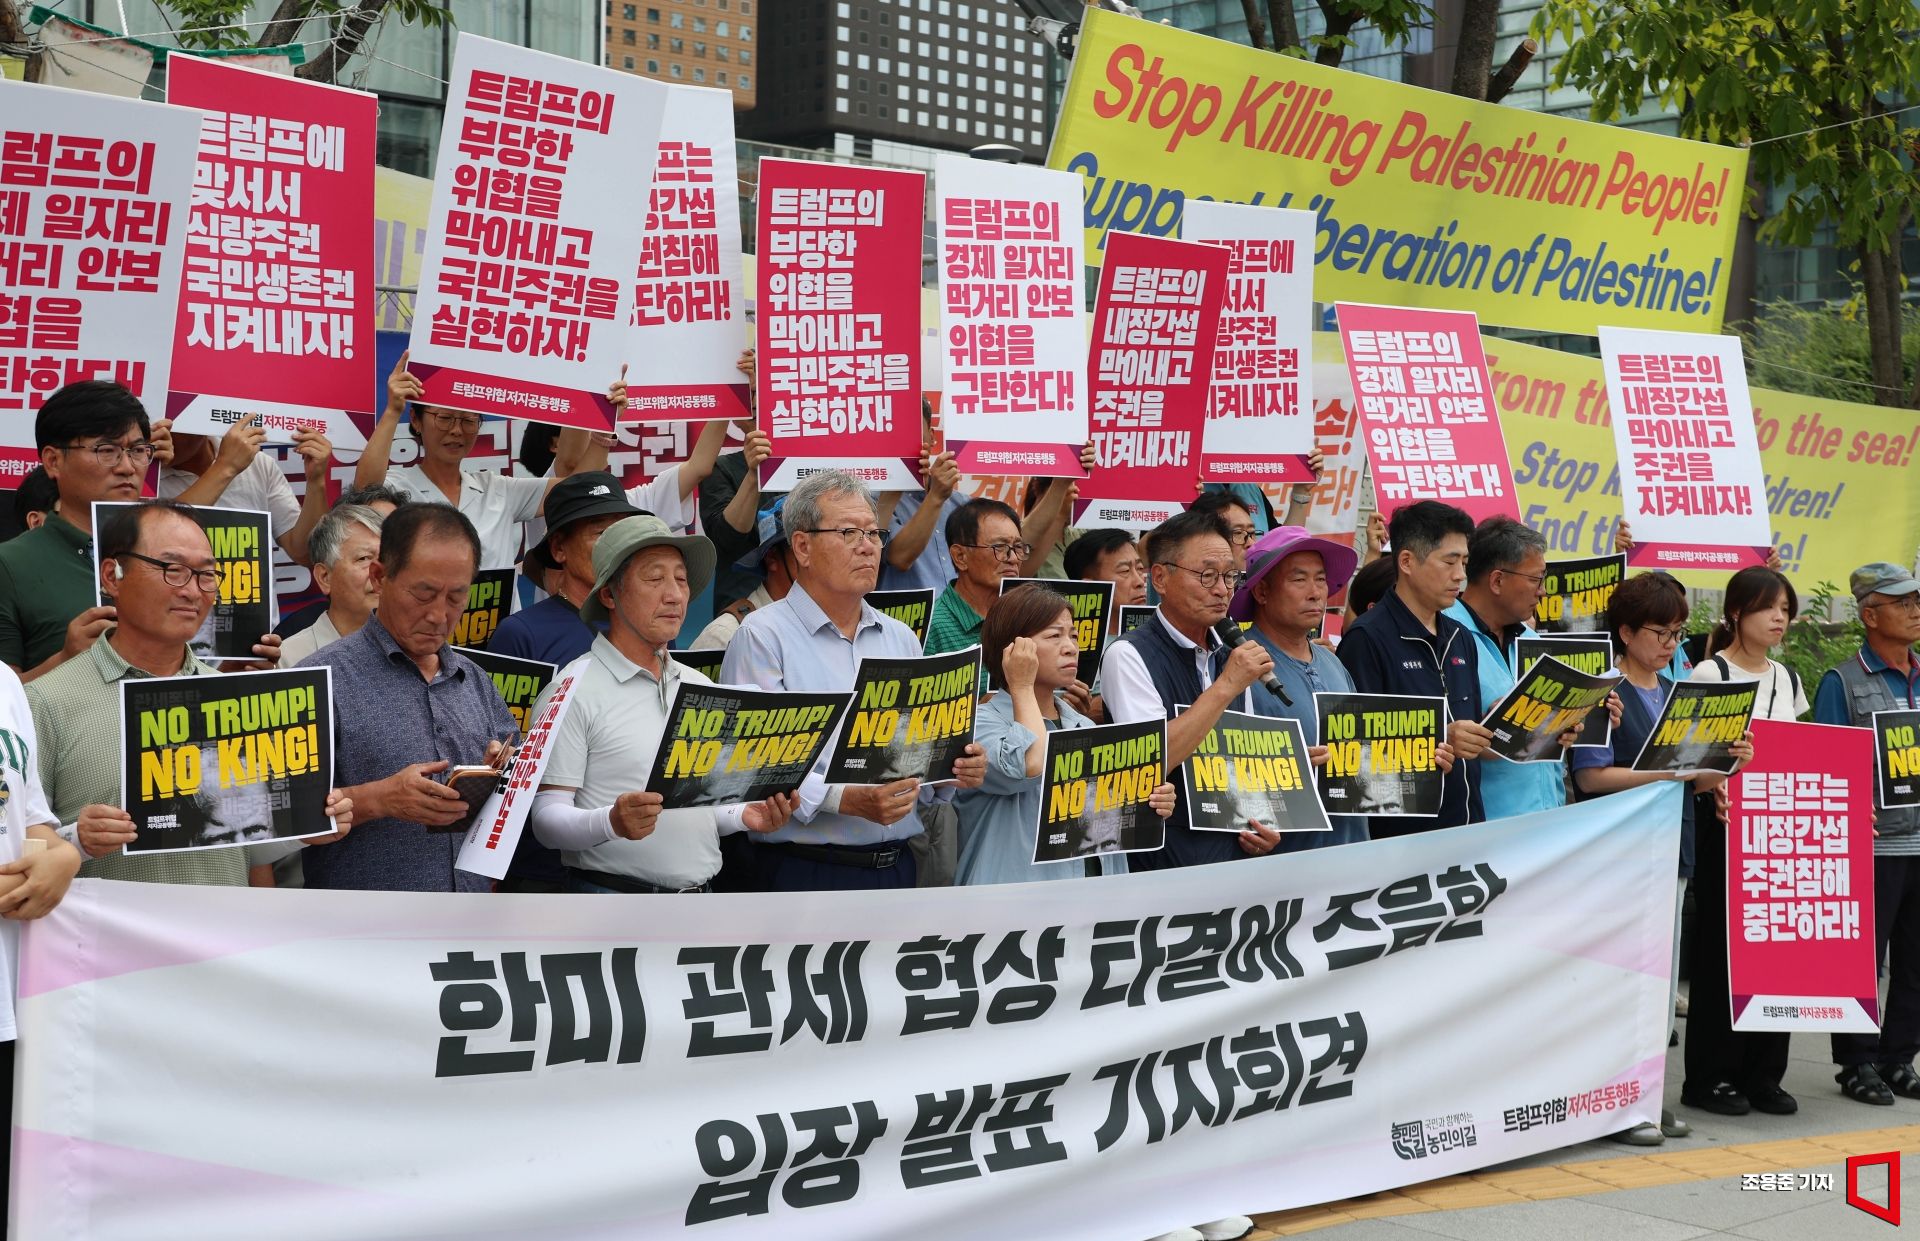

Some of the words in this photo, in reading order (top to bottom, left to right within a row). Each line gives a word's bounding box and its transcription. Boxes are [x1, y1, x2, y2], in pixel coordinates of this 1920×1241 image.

[465, 69, 615, 135] 트럼프의
[200, 112, 344, 172] 트럼프에
[458, 116, 573, 174] 부당한
[1093, 43, 1222, 153] Stop
[1220, 75, 1383, 187] Killing
[1376, 110, 1601, 208] Palestinian
[1602, 150, 1730, 235] People!
[1, 131, 155, 194] 럼프의
[653, 142, 713, 183] 프는
[191, 162, 301, 217] 맞서서
[451, 166, 563, 220] 위협을
[645, 187, 716, 230] 간섭
[770, 187, 885, 227] 트럼프의
[0, 190, 30, 237] 제
[43, 194, 171, 246] 일자리
[188, 211, 320, 263] 식량주권
[945, 197, 1060, 242] 트럼프의
[1066, 152, 1264, 250] Supp
[1278, 192, 1490, 291] iberation
[1491, 221, 1545, 296] of
[1532, 236, 1722, 314] Palestine!
[445, 210, 593, 270] 막아내고
[637, 233, 720, 278] 권침해
[769, 229, 857, 269] 부당한
[1198, 240, 1294, 274] 럼프에
[0, 241, 63, 289] 거리
[76, 246, 161, 293] 안보
[945, 244, 995, 280] 경제
[1004, 245, 1074, 280] 일자리
[187, 256, 354, 310] 국민생존권
[437, 257, 619, 320] 국민주권을
[769, 271, 853, 311] 위협을
[947, 284, 1019, 318] 먹거리
[1027, 284, 1074, 318] 안보
[1110, 266, 1207, 306] 트럼프의
[1222, 279, 1265, 313] 서서
[0, 293, 82, 350] 협을
[629, 280, 731, 327] 단하라!
[187, 302, 354, 359] 지켜내자!
[430, 304, 590, 362] 실현하자!
[769, 313, 882, 353] 막아내고
[949, 324, 1035, 367] 위협을
[1104, 308, 1198, 347] 내정간섭
[1216, 316, 1276, 347] 량주권
[1348, 330, 1462, 364] 트럼프의
[770, 353, 910, 396] 국민주권을
[1099, 349, 1194, 387] 막아내고
[1211, 349, 1298, 380] 민생존권
[1355, 366, 1405, 393] 경제
[1412, 366, 1483, 395] 일자리
[1617, 354, 1723, 385] 트럼프의
[951, 370, 1075, 415] 규탄한다!
[1093, 391, 1164, 428] 주권을
[1361, 396, 1434, 424] 먹거리
[1438, 397, 1488, 424] 안보
[1623, 386, 1729, 417] 내정간섭
[771, 396, 893, 438] 실현하자!
[1628, 418, 1736, 449] 막아내고
[1091, 431, 1191, 469] 지켜내자!
[1371, 428, 1456, 462] 위협을
[1786, 413, 1842, 461] the
[1846, 412, 1919, 467] sea!
[1378, 464, 1503, 499] 규탄한다!
[1515, 441, 1600, 503] Stop
[1633, 452, 1714, 483] 주권을
[1638, 485, 1753, 517] 지켜내자!
[1764, 474, 1845, 521] dren!
[213, 560, 261, 605] NG!
[1564, 563, 1620, 593] TRUMP!
[1536, 595, 1563, 621] NO
[1571, 583, 1618, 618] KING
[450, 609, 497, 647] NG!
[860, 680, 901, 709] NO
[907, 662, 976, 706] TRUMP!
[1525, 675, 1564, 703] NO
[1668, 698, 1697, 718] NO
[1699, 690, 1754, 717] TRUMP!
[141, 706, 190, 748] NO
[201, 686, 316, 738] TRUMP!
[677, 708, 726, 738] NO
[733, 704, 836, 737] TRUMP!
[847, 709, 899, 748] NO
[904, 693, 973, 746] KING!
[1327, 713, 1356, 741] NO
[1362, 710, 1436, 735] TRUMP!
[1502, 695, 1551, 731] NO
[1654, 719, 1692, 746] NO
[1691, 713, 1748, 744] KING!
[663, 740, 723, 779] NO
[724, 731, 822, 775] KING!
[1054, 750, 1083, 782] NO
[1090, 732, 1160, 774] TRUMP!
[1193, 728, 1217, 754] NO
[1223, 728, 1293, 756] TRUMP!
[1327, 741, 1360, 778] NO
[1370, 737, 1436, 774] KING!
[1886, 726, 1915, 749] NO
[141, 744, 201, 802] NO
[217, 723, 319, 789] KING!
[1192, 757, 1229, 792] NO
[1232, 757, 1303, 792] KING!
[1888, 747, 1920, 778] NO
[1049, 782, 1087, 824] NO
[1094, 763, 1161, 813] KING!
[1742, 772, 1848, 812] 트럼프는
[1742, 815, 1848, 855] 내정간섭
[1742, 858, 1849, 898] 주권침해
[1743, 901, 1859, 943] 중단하라!
[429, 947, 646, 1078] 한미
[677, 940, 870, 1058] 관세
[896, 925, 1066, 1036] 협상
[1080, 898, 1304, 1010] 타결에
[1313, 863, 1507, 971] 즈음한
[685, 1100, 888, 1226] 입장
[900, 1072, 1071, 1189] 발표
[1093, 1011, 1368, 1153] 기자회견
[1425, 1118, 1445, 1130] 국민과
[1446, 1112, 1474, 1127] 함께하는
[1427, 1124, 1478, 1155] 농민의길
